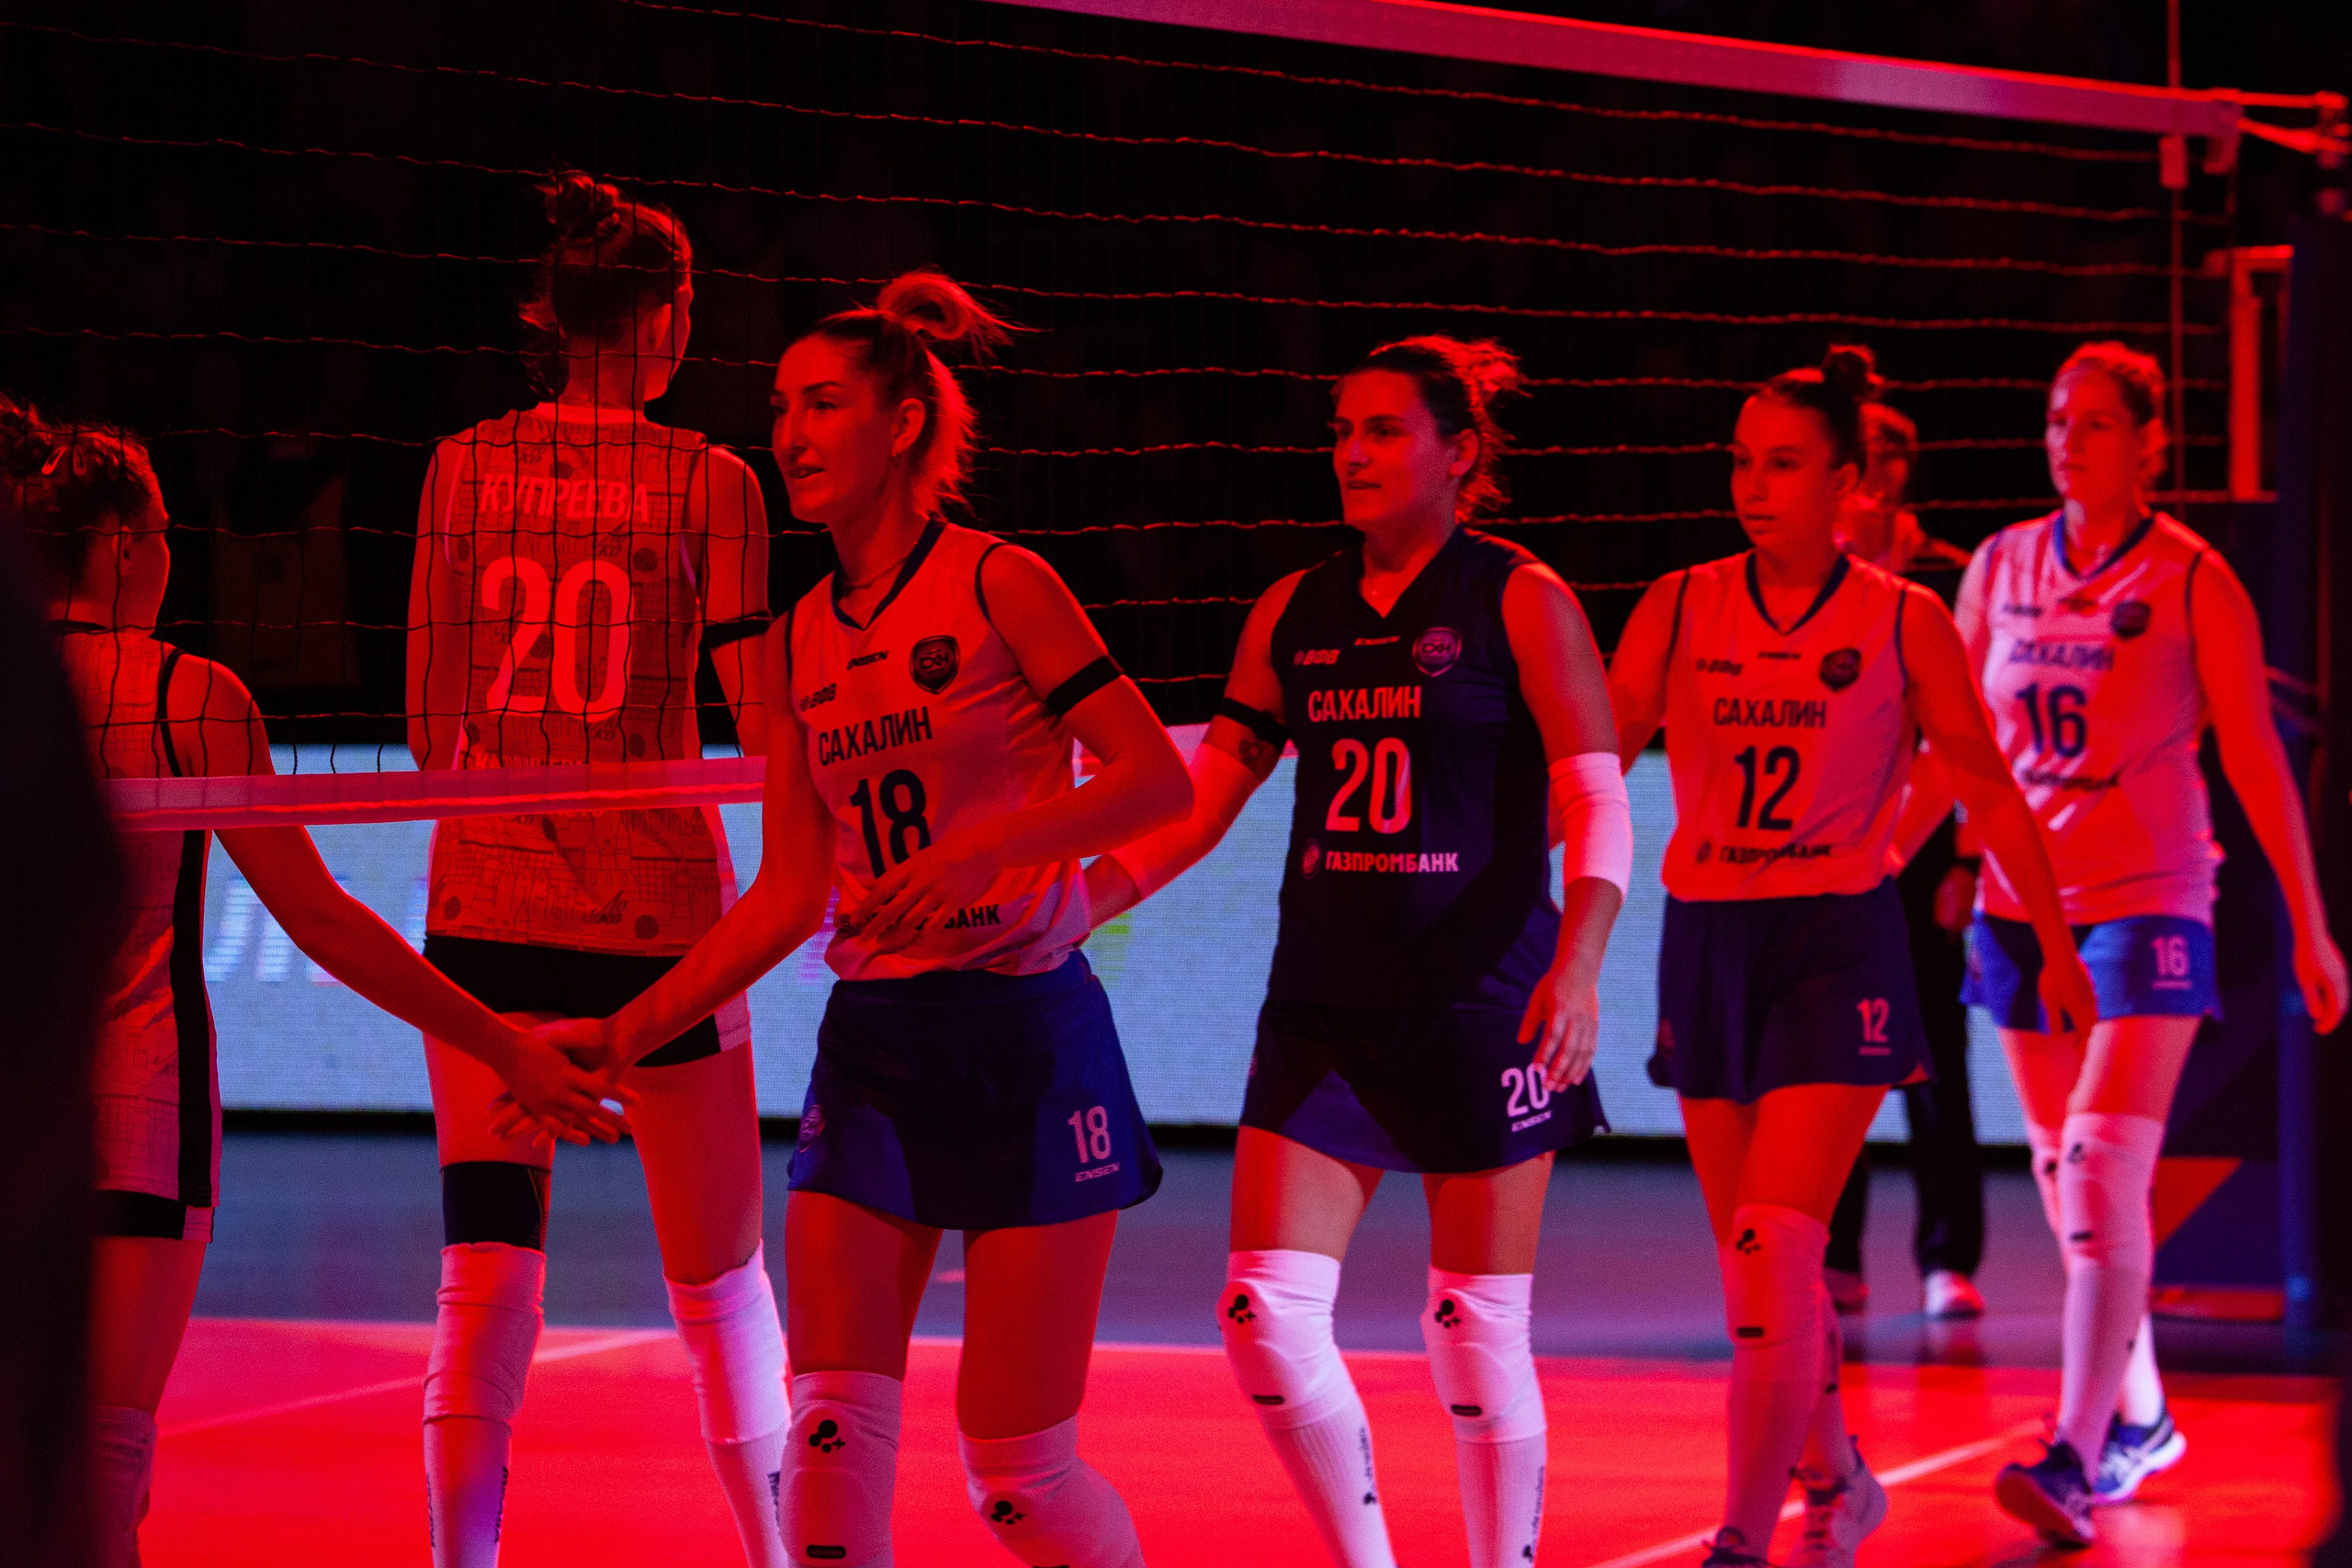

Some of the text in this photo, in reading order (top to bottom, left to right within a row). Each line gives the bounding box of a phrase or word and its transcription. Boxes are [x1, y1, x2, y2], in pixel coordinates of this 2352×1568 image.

[480, 472, 649, 523] КУПРЕЕВА
[481, 555, 631, 724] 20
[1308, 686, 1421, 723] САХАЛИН
[1713, 697, 1827, 728] САХАЛИН
[2015, 682, 2087, 759] 16
[818, 706, 933, 766] САХАЛИН
[1326, 738, 1411, 834] 20
[1734, 746, 1801, 831] 12
[850, 769, 932, 879] 18
[1326, 851, 1460, 873] ГАЗПРОМБАНК
[2151, 935, 2190, 977] 16
[1857, 998, 1890, 1043] 12
[1500, 1063, 1551, 1117] 20
[1068, 1105, 1112, 1164] 18
